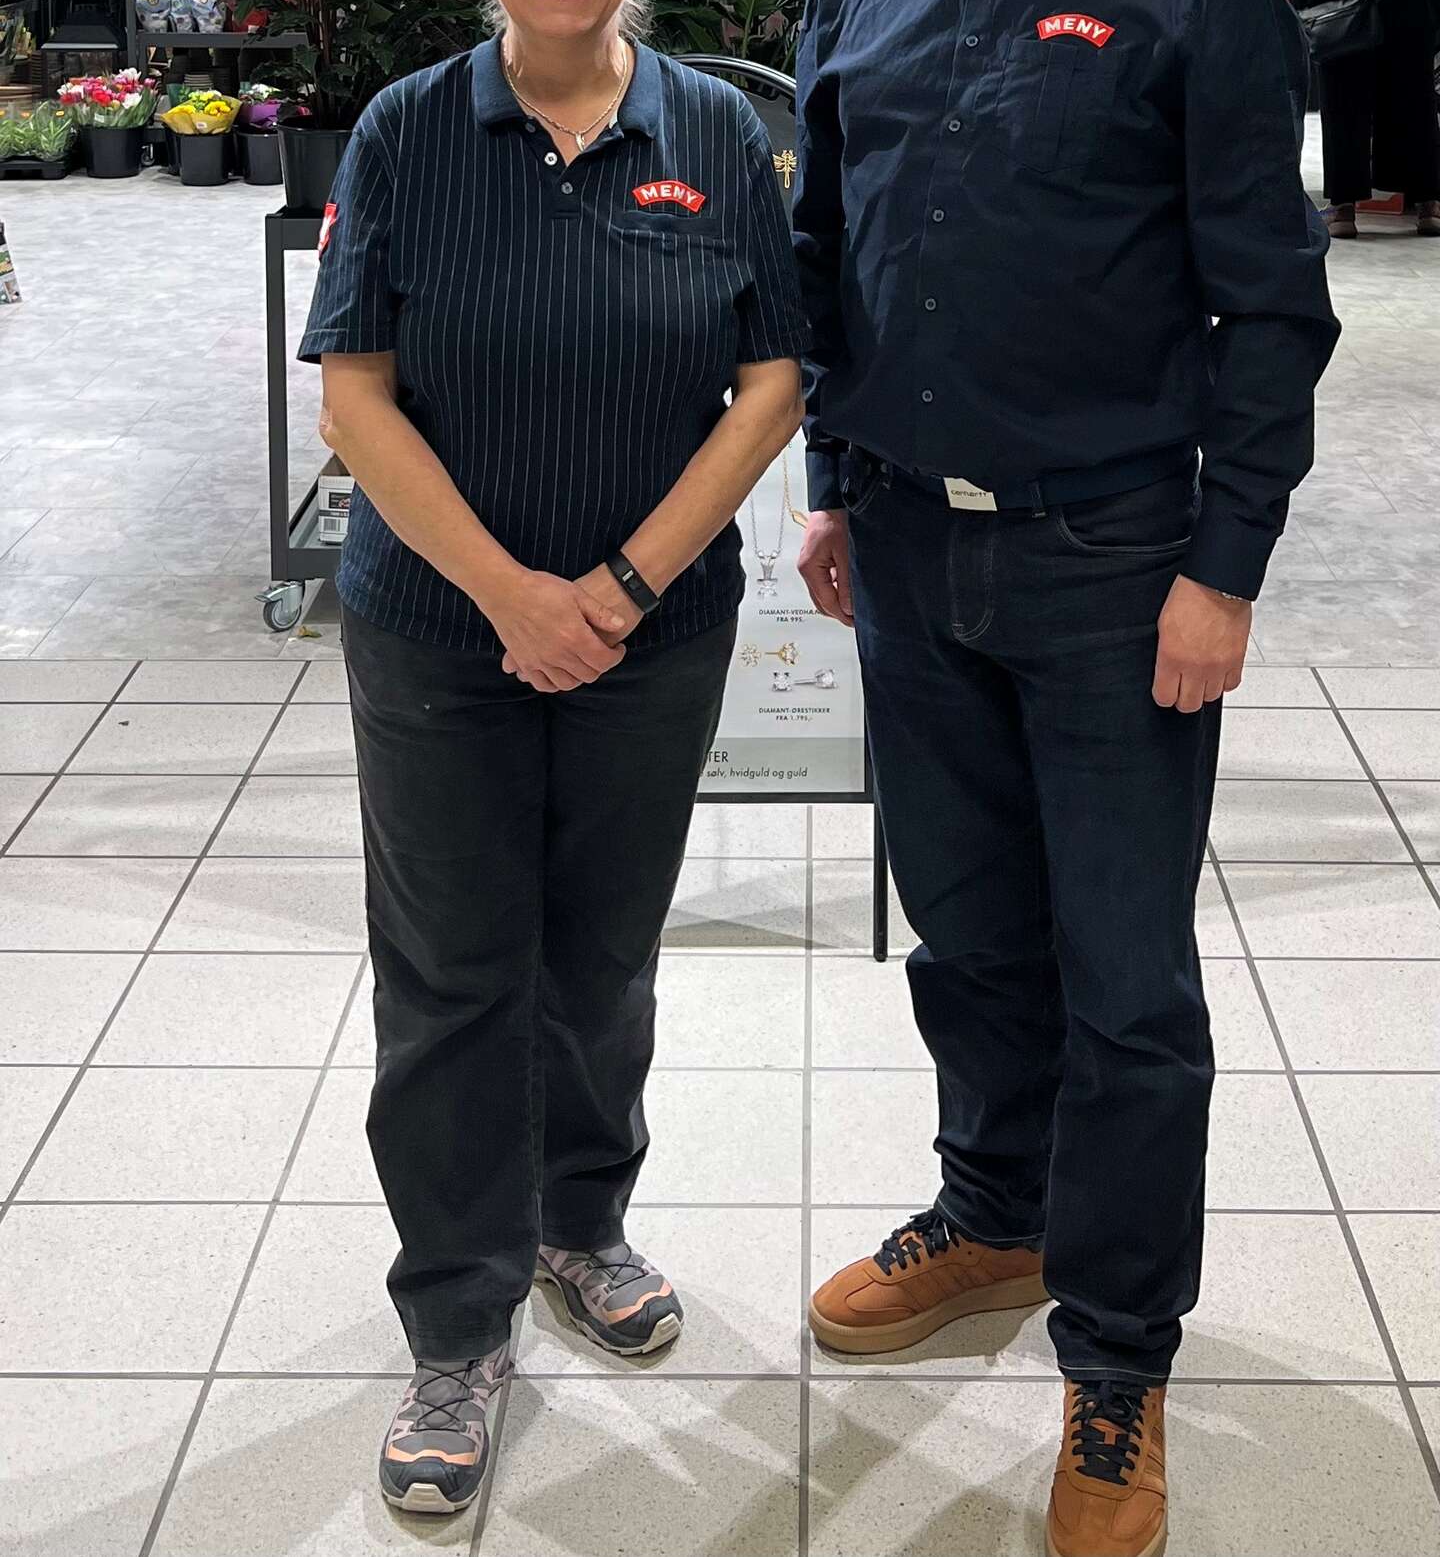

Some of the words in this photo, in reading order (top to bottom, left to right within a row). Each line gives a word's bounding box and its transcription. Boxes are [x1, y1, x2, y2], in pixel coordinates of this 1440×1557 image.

[1044, 17, 1106, 39] MENY
[640, 184, 697, 204] MENY
[707, 751, 729, 763] TER
[730, 767, 770, 779] hvidguld
[772, 770, 785, 779] og
[787, 767, 808, 779] guld
